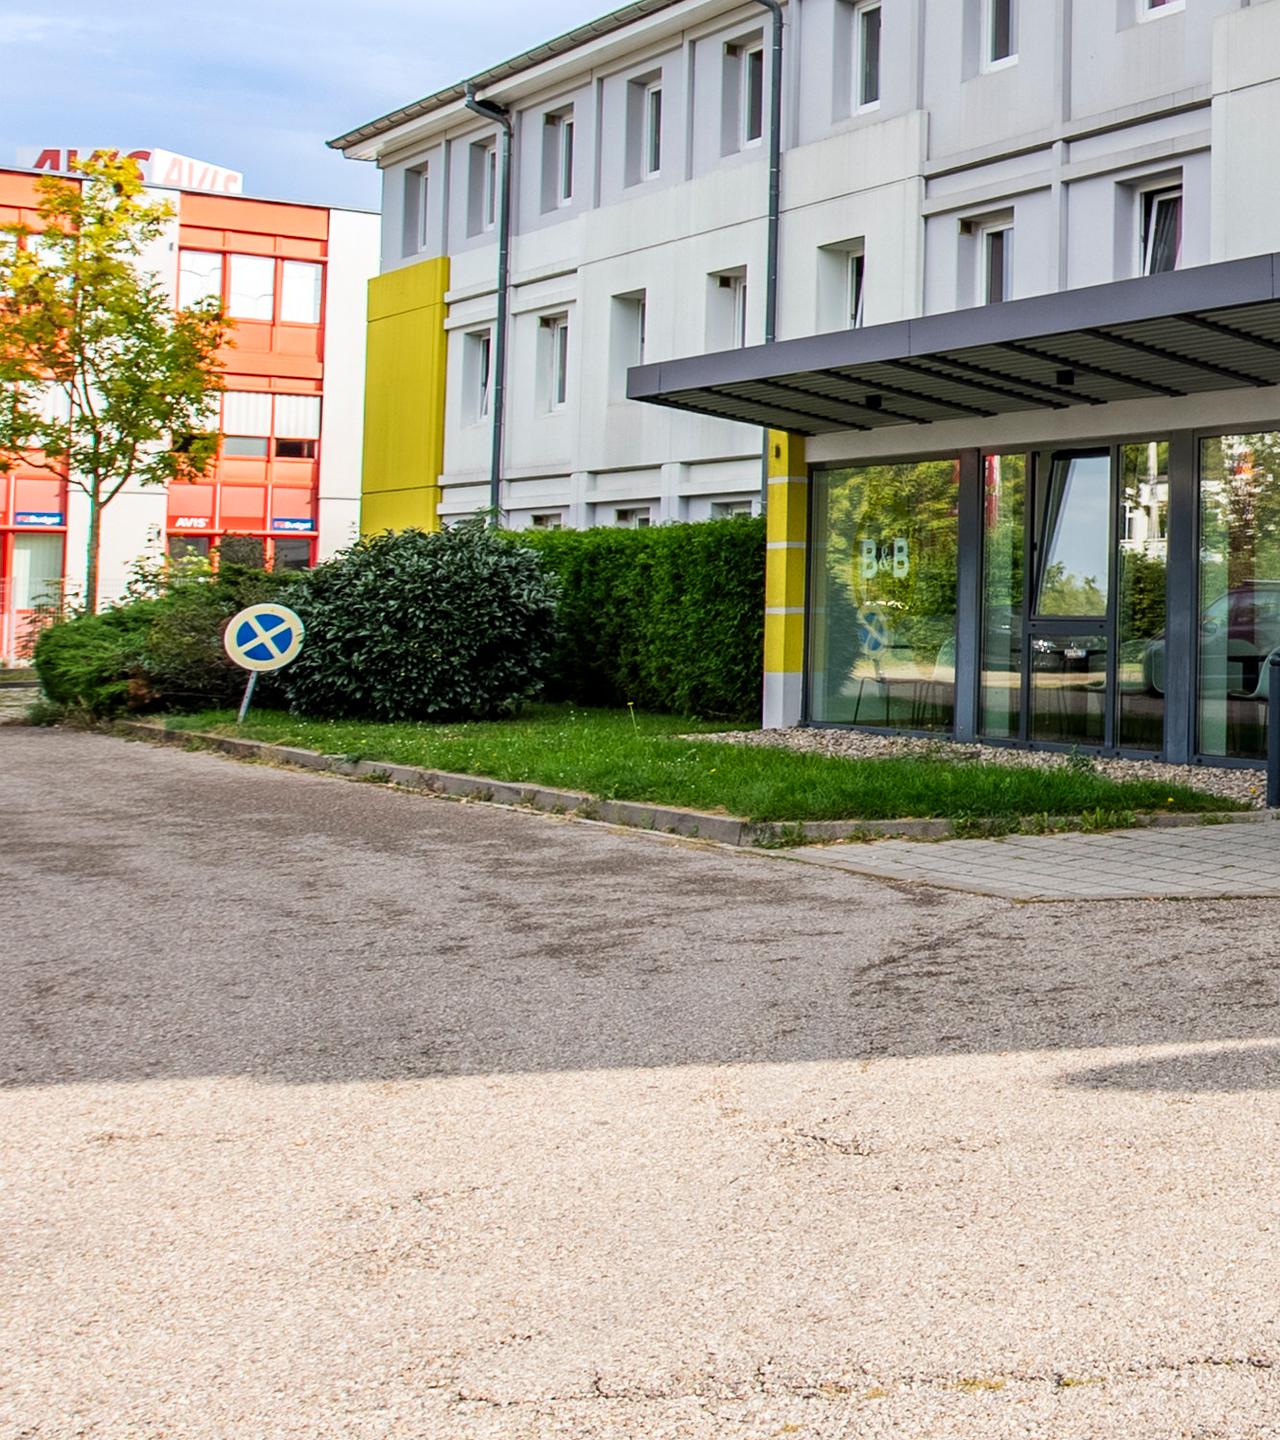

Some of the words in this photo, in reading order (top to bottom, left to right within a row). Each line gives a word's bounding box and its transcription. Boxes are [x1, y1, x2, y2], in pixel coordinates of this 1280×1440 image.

[163, 157, 239, 192] AVIS
[175, 517, 207, 529] AVIS
[861, 537, 910, 580] B&B
